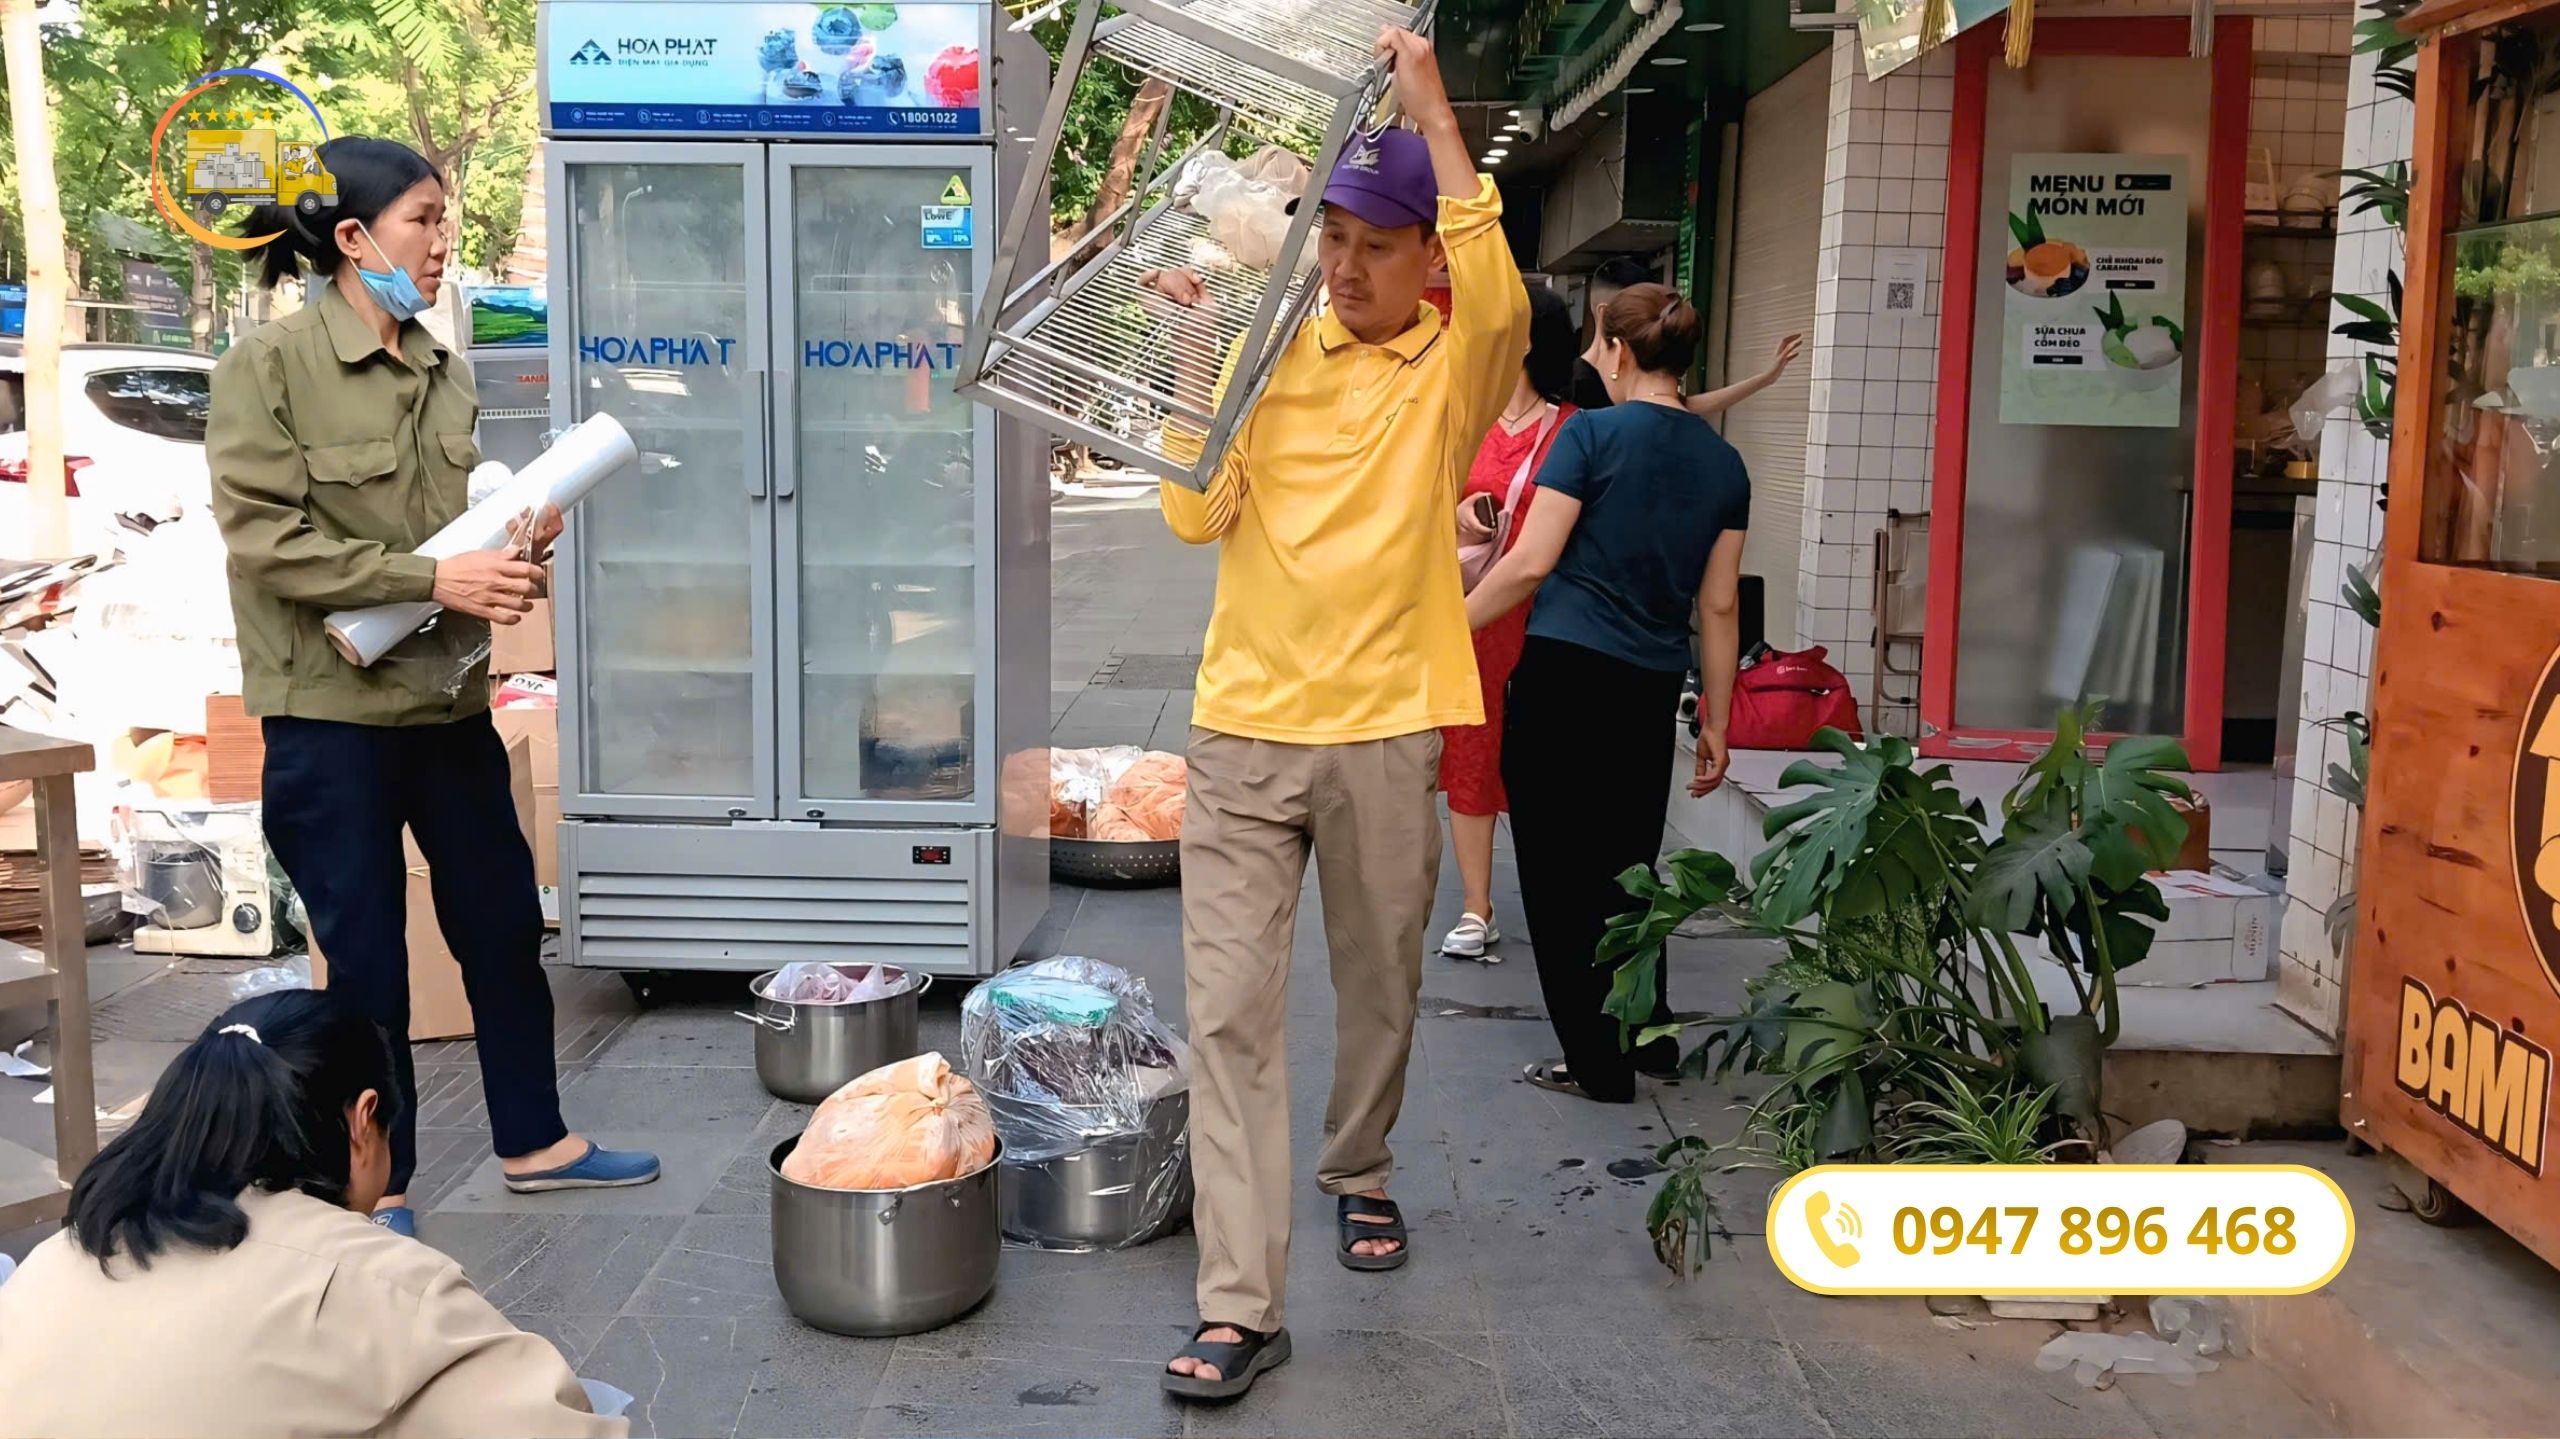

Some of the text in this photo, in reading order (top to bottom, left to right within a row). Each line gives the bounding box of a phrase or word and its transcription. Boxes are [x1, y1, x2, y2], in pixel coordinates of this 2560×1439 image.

[2031, 175, 2104, 193] MENU
[2031, 192, 2144, 215] MÓN MỚI
[2057, 327, 2086, 335] CHUA
[2398, 981, 2549, 1171] BAMI
